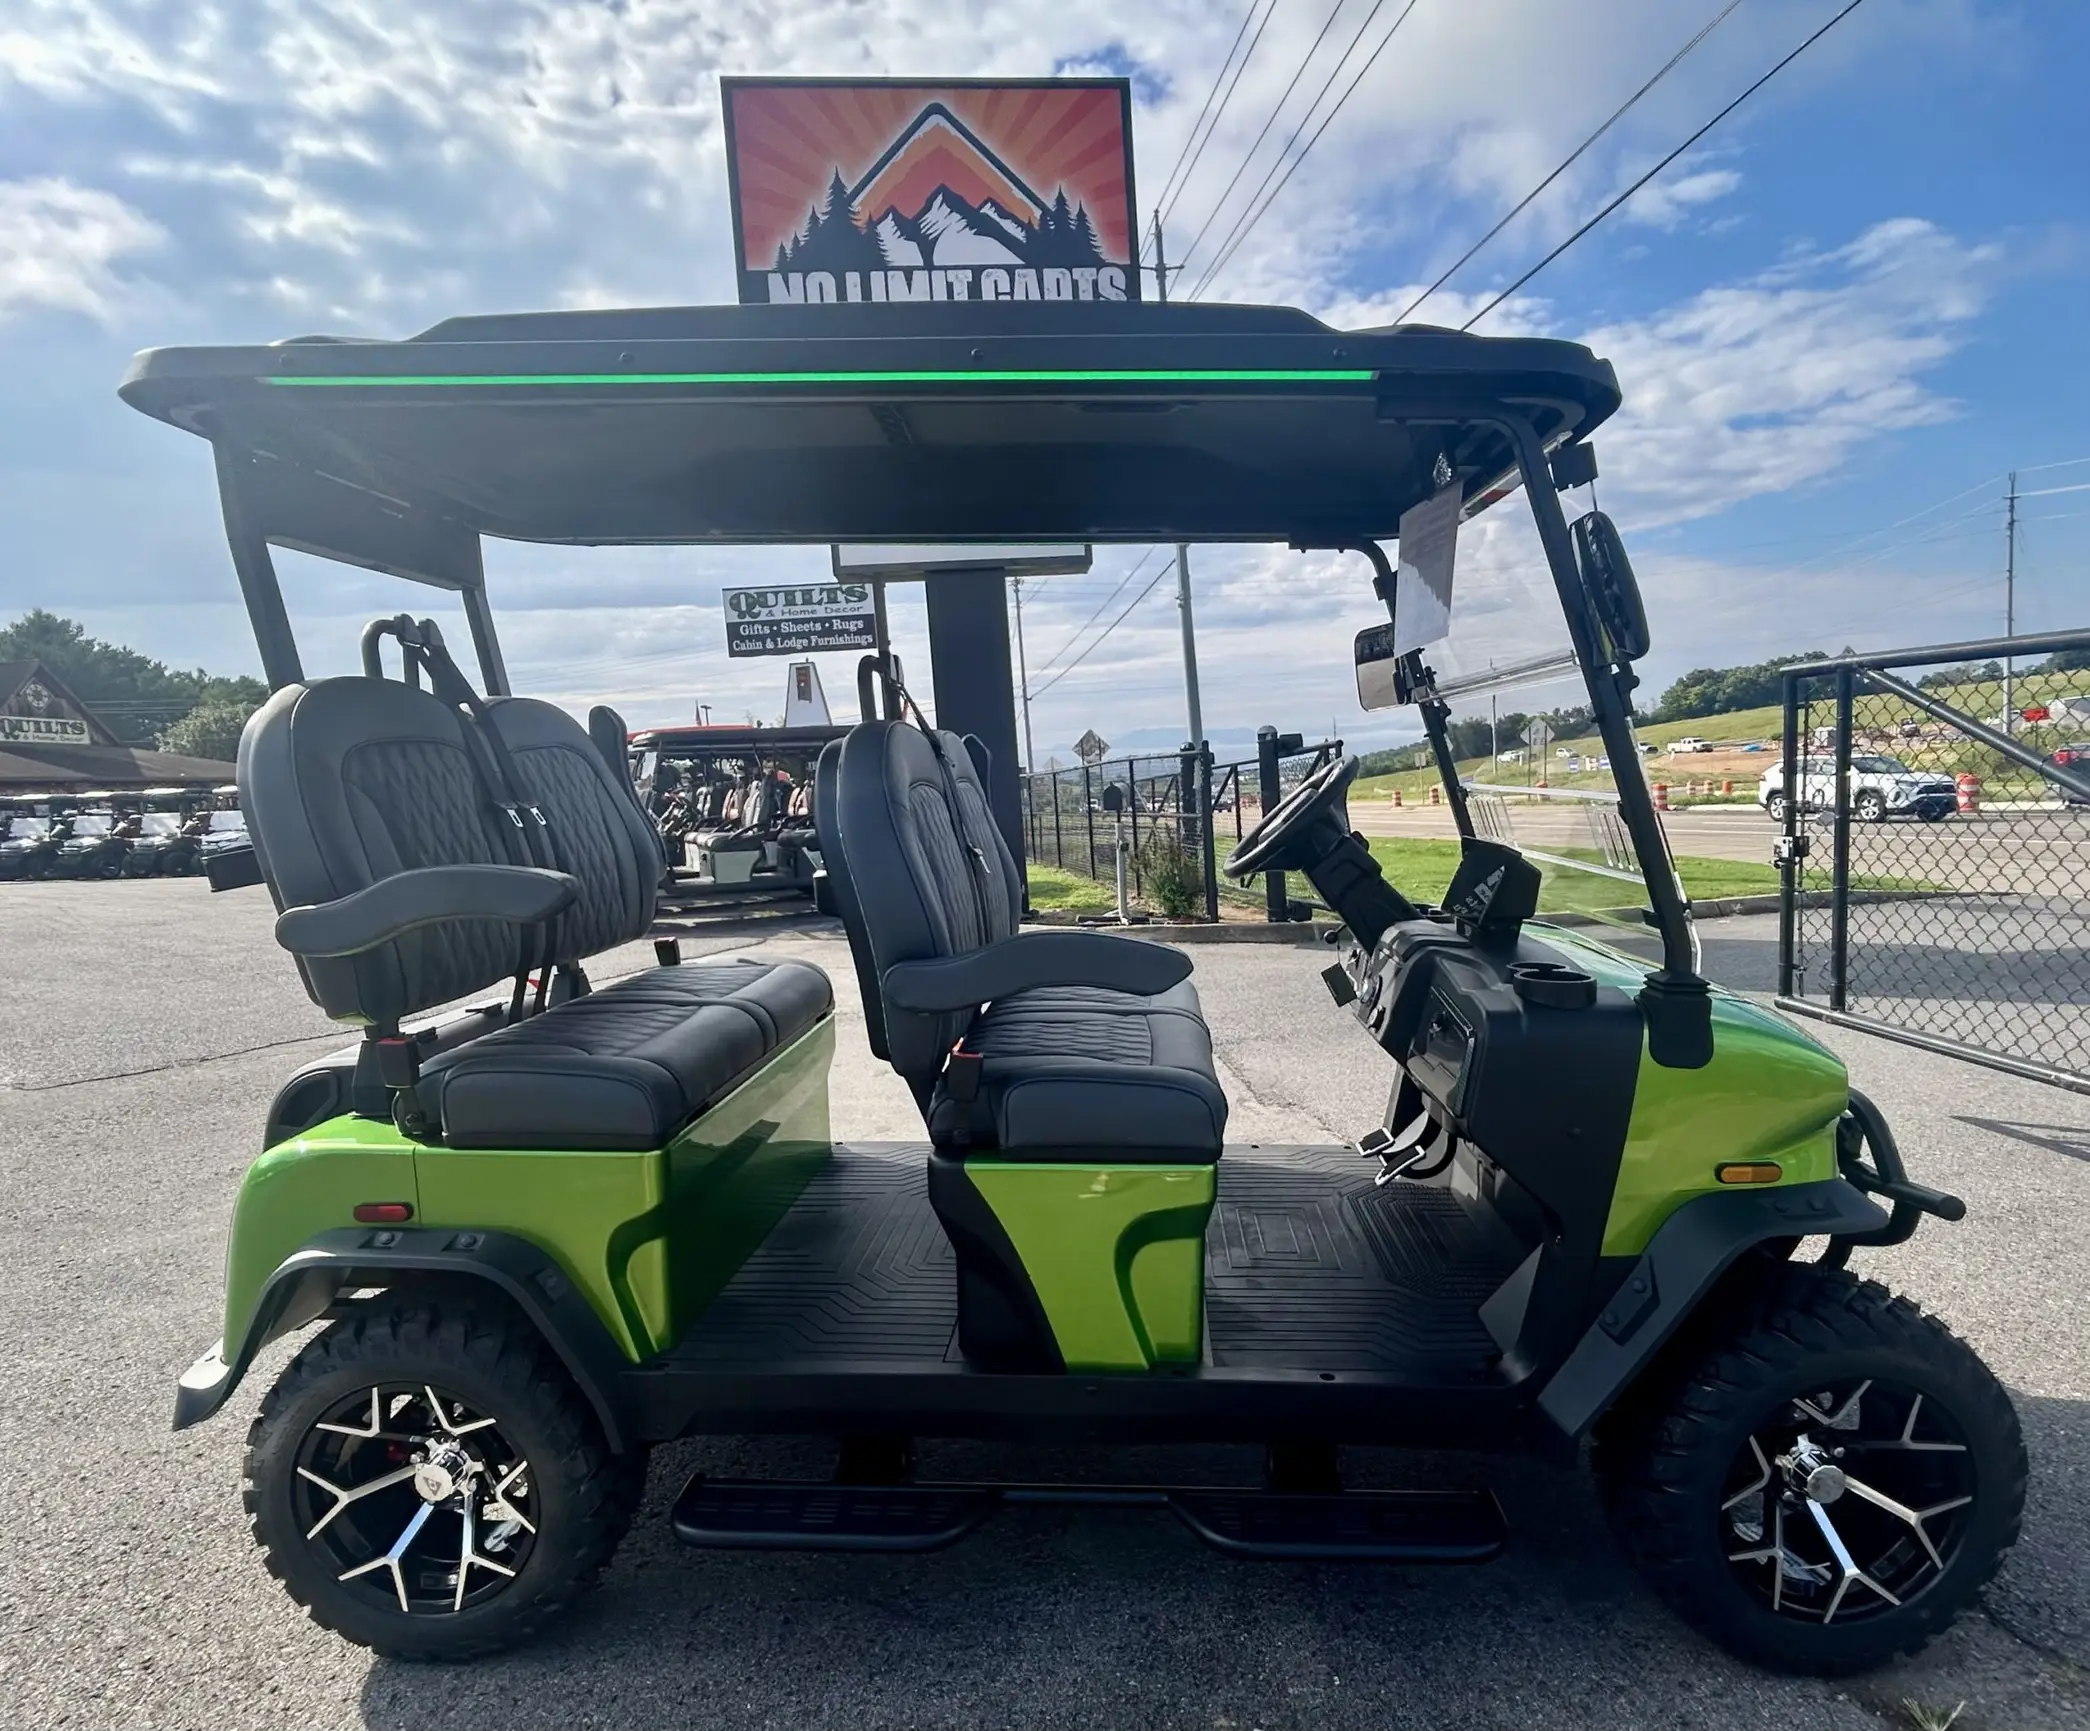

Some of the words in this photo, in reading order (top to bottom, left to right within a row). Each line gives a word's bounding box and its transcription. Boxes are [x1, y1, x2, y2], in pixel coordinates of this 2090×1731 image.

[767, 271, 837, 304] NO
[729, 585, 868, 619] QUILTS
[765, 609, 775, 618] &
[781, 607, 818, 617] Home
[824, 605, 864, 614] Decor
[739, 622, 771, 636] Gifts
[780, 619, 822, 634] Sheets
[832, 618, 864, 633] Rugs
[732, 637, 763, 651] Cabin
[765, 637, 775, 649] &
[777, 634, 809, 650] Lodge
[811, 632, 873, 647] Furnishings
[0, 718, 86, 740] QUILTS
